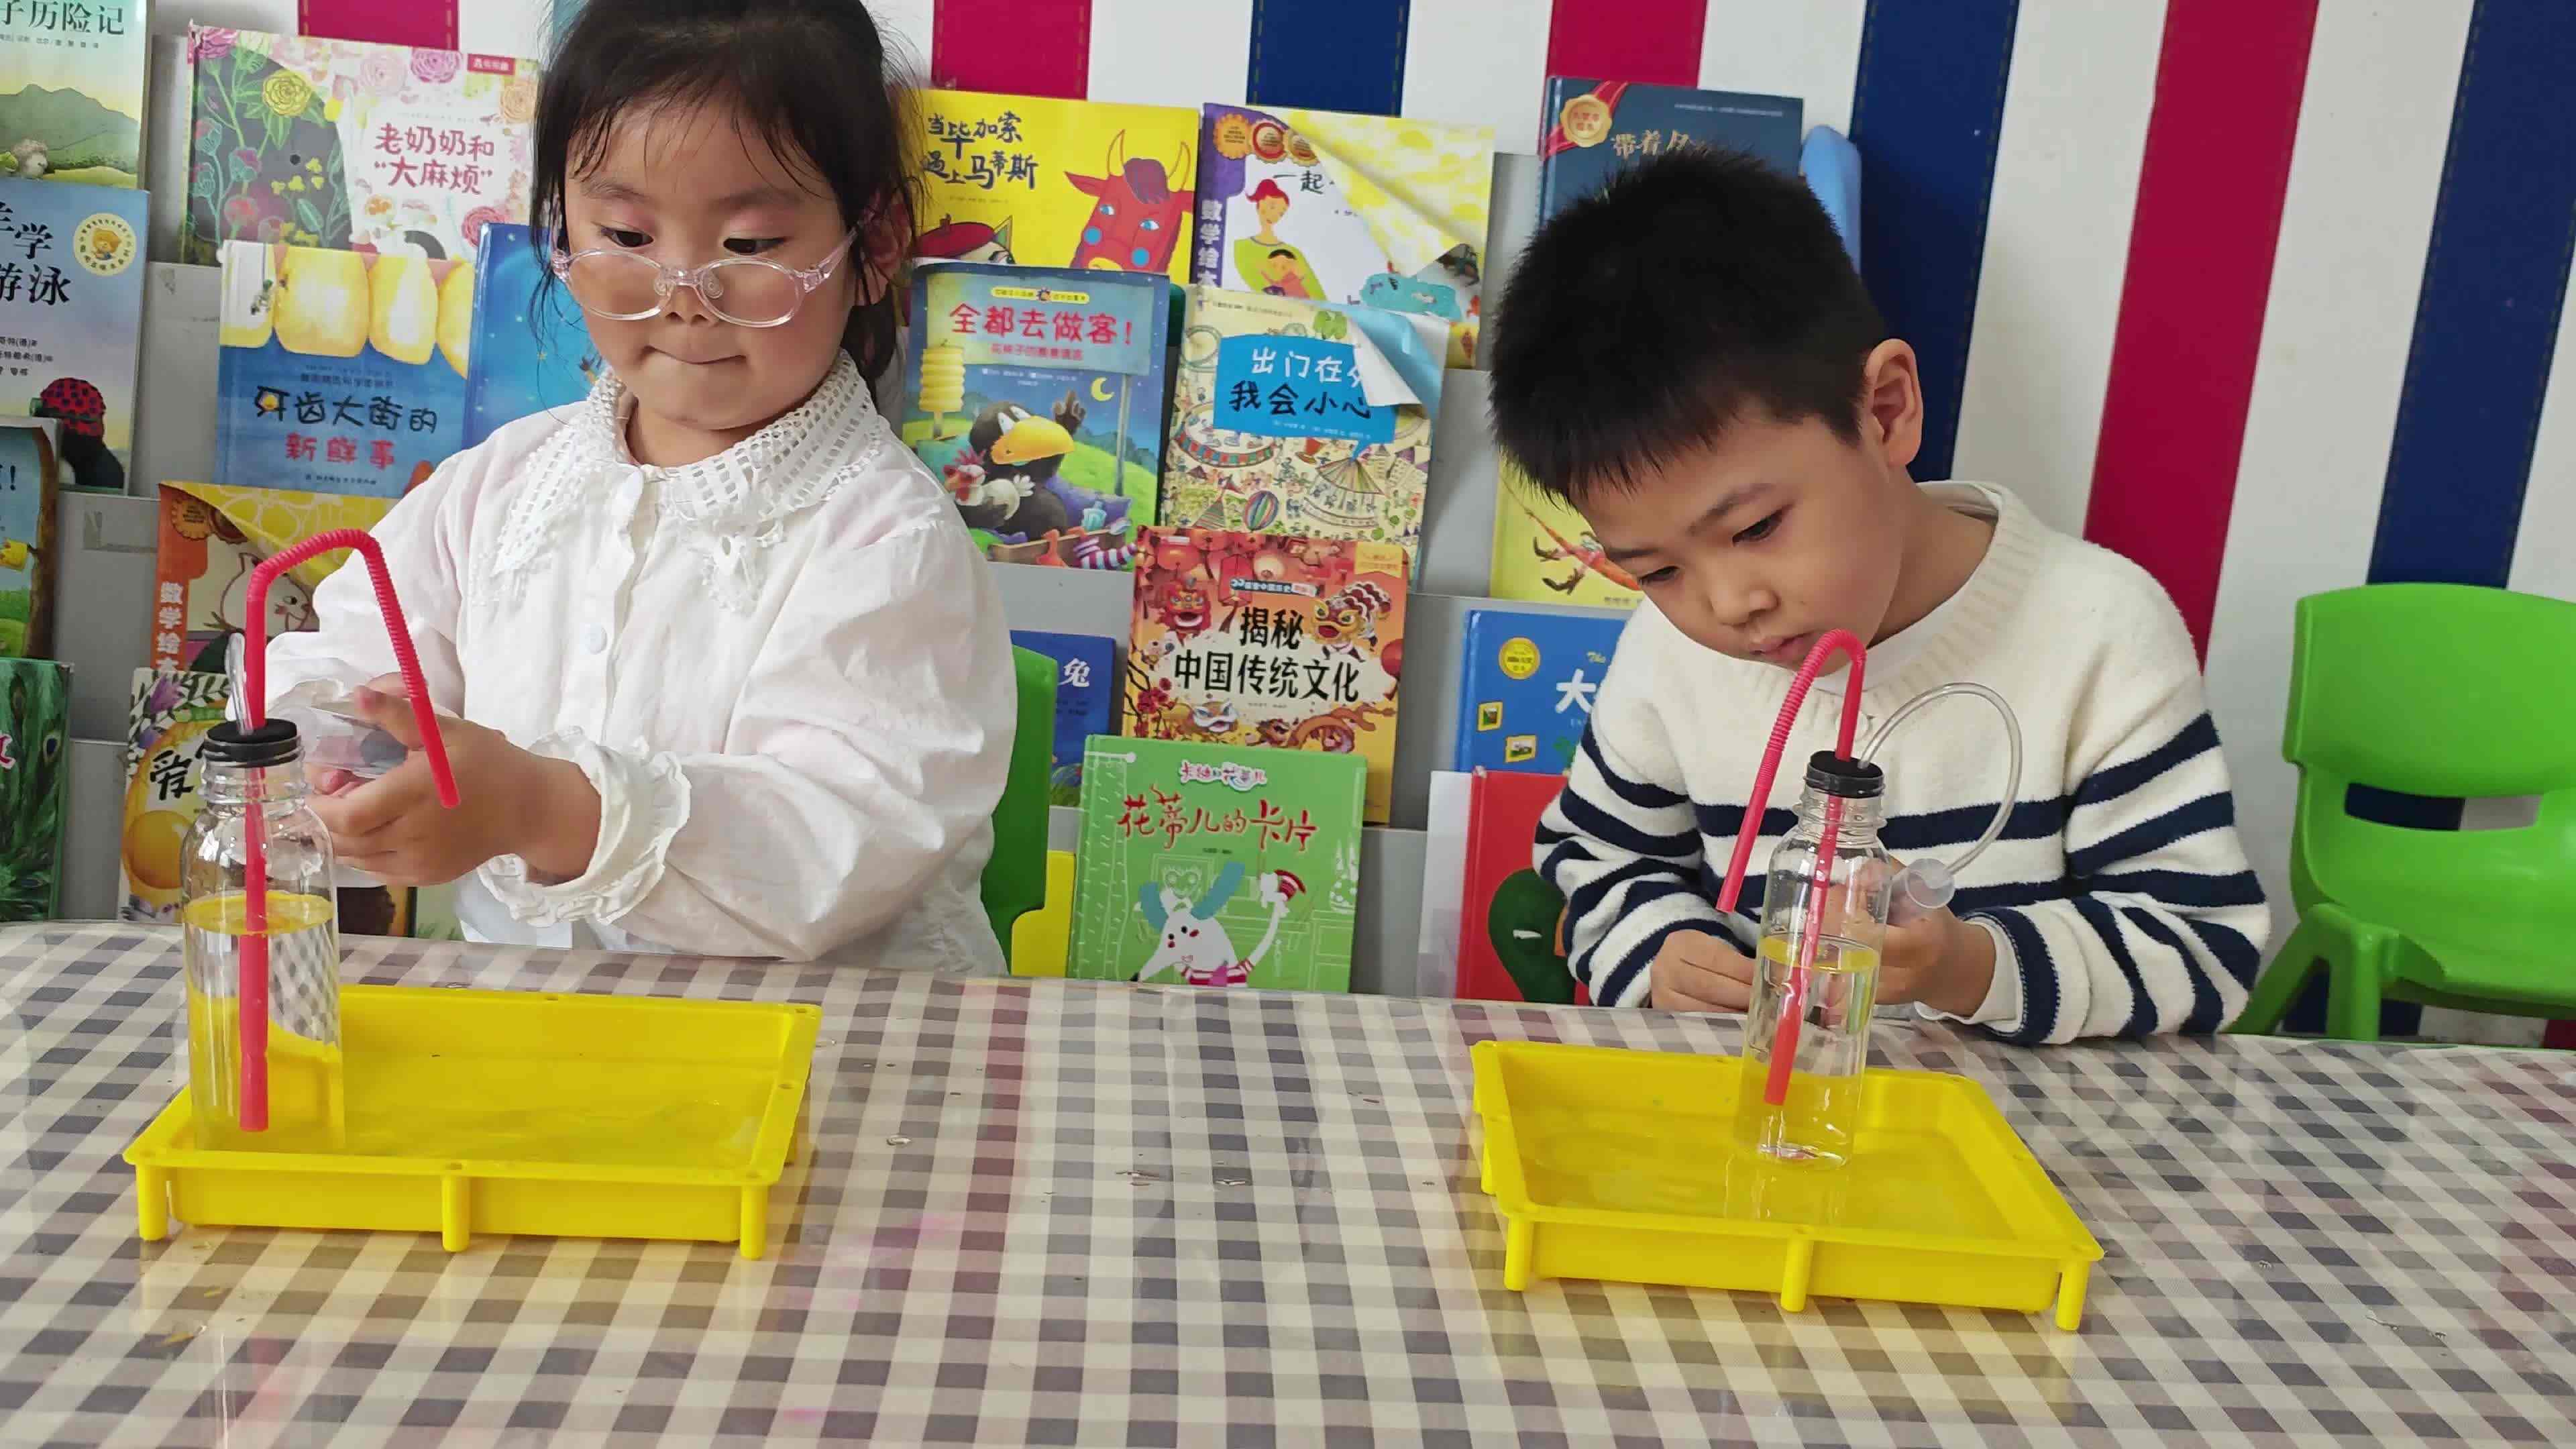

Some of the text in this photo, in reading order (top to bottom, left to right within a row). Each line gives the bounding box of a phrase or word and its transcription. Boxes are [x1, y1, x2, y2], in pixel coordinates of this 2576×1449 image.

[374, 122, 494, 162] 老奶奶和
[928, 111, 1022, 160] 当毕加索
[922, 150, 1039, 190] 遇上马蒂斯
[1273, 170, 1335, 195] 一起
[254, 385, 437, 434] 牙齿大街的
[1229, 380, 1372, 419] 我会小心
[285, 432, 396, 470] 新鲜事
[1240, 606, 1305, 650] 揭秘
[1057, 657, 1090, 688] 兔
[1175, 649, 1360, 703] 中国传统文化
[1555, 668, 1597, 714] 大
[1117, 784, 1318, 852] 花蒂儿的卡片
